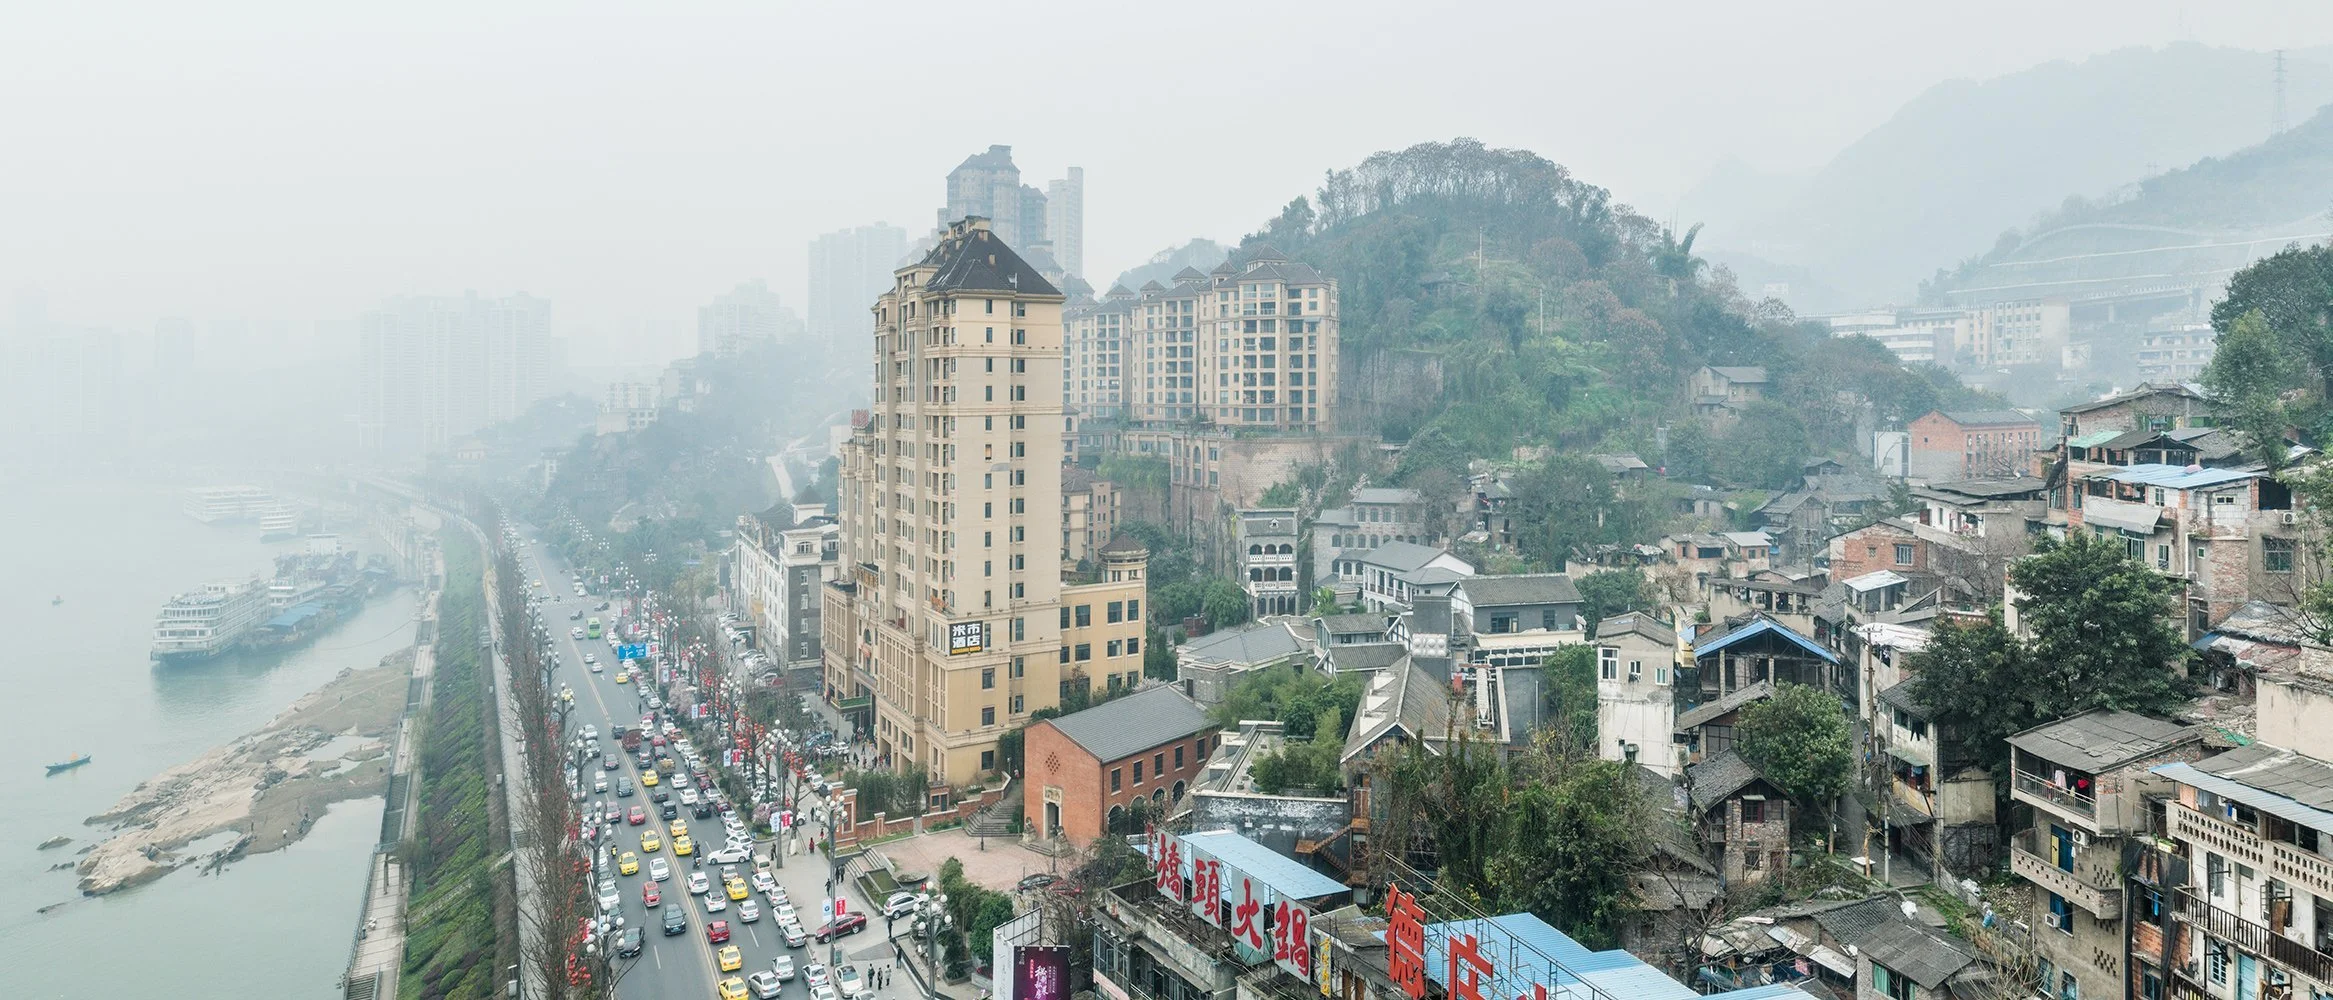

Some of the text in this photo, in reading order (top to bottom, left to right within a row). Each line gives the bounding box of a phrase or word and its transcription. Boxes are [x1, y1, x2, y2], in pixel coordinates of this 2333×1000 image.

[953, 635, 980, 648] 酒店
[1157, 833, 1309, 977] 橋頭火鍋
[1385, 882, 1547, 1000] 德庄
